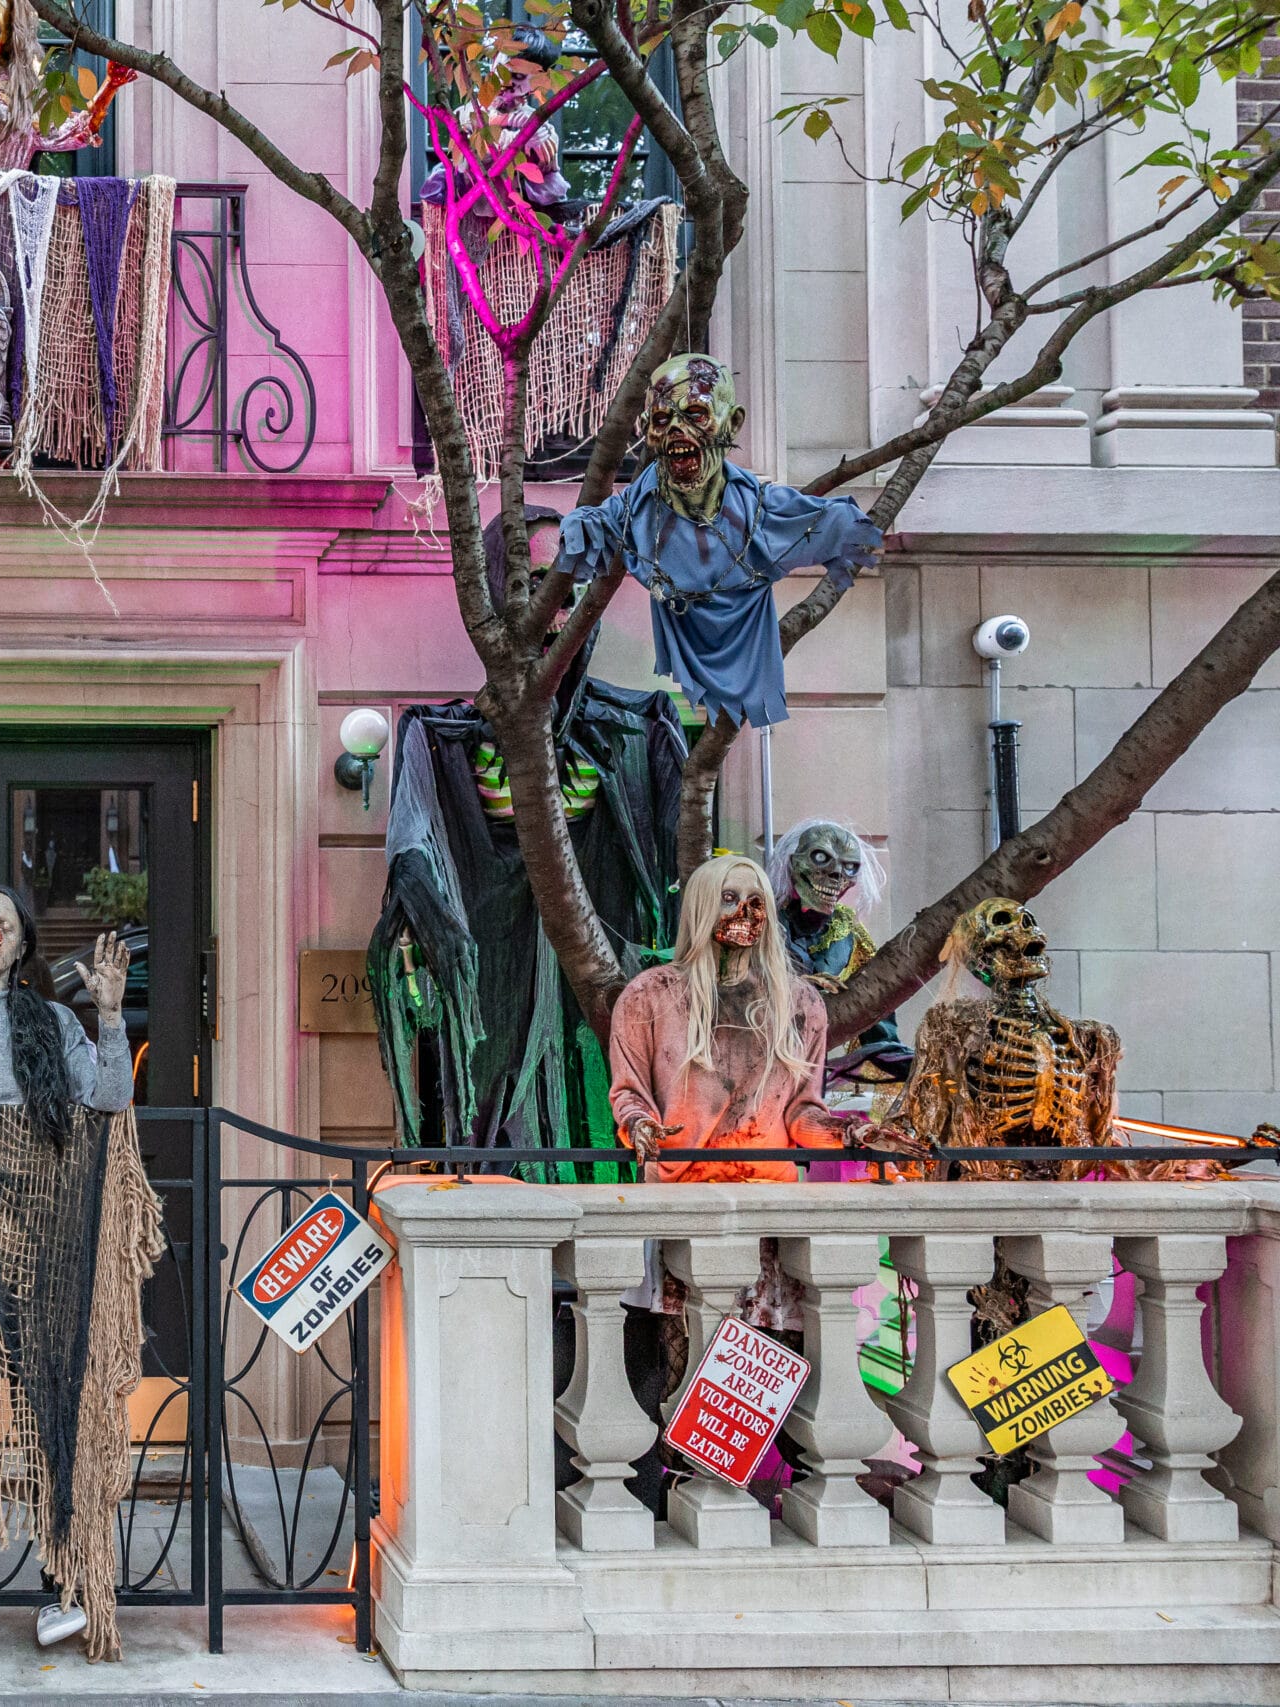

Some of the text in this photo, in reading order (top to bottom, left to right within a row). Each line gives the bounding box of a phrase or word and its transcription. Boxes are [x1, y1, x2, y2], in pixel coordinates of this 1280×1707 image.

[258, 1212, 340, 1298] BEWARE
[310, 1265, 333, 1293] OF
[289, 1243, 384, 1344] ZOMBIES
[722, 1323, 801, 1383] DANGER
[722, 1349, 784, 1395] ZOMBIE
[698, 1382, 770, 1437] VIOLATORS
[721, 1373, 767, 1408] AREA
[984, 1351, 1088, 1423] WARNING
[1008, 1382, 1093, 1444] ZOMBIES
[686, 1431, 736, 1470] EATEN!
[696, 1409, 750, 1452] WILL BE
